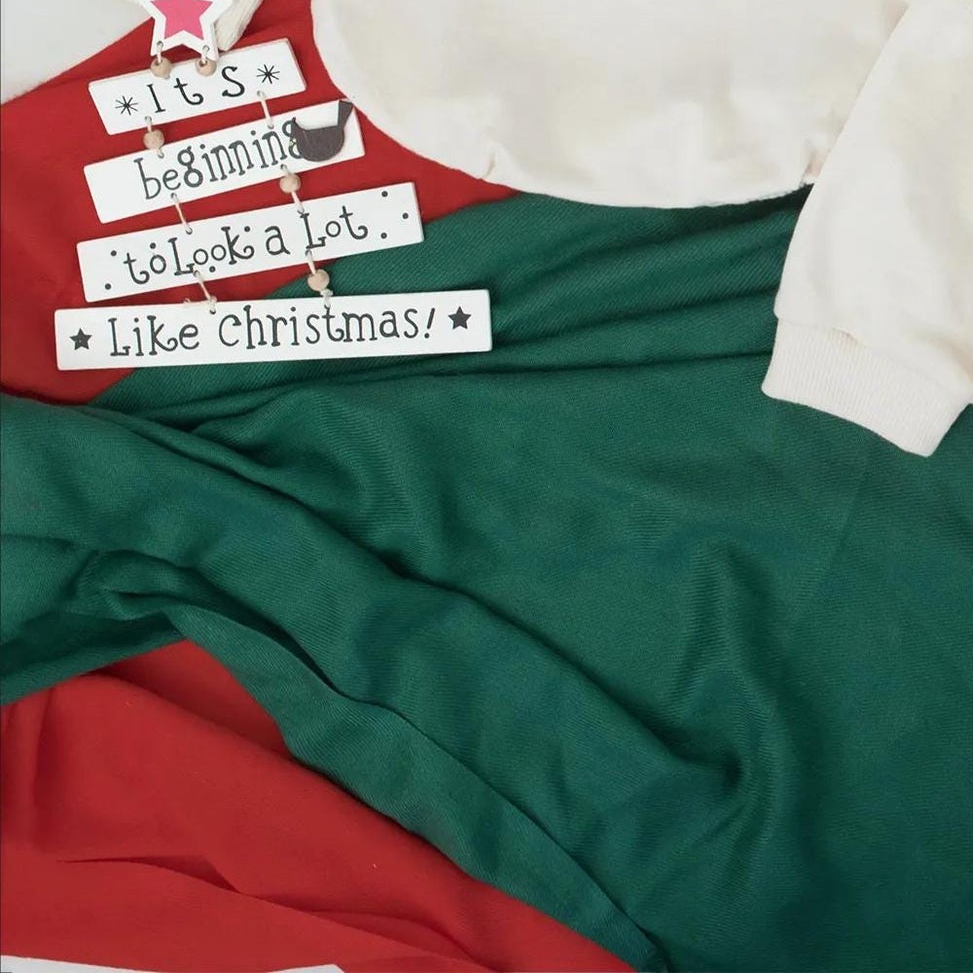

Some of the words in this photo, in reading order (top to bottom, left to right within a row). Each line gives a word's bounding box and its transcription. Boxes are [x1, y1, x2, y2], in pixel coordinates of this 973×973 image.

[264, 225, 291, 256] a
[299, 205, 369, 250] Lot
[108, 316, 200, 357] Like
